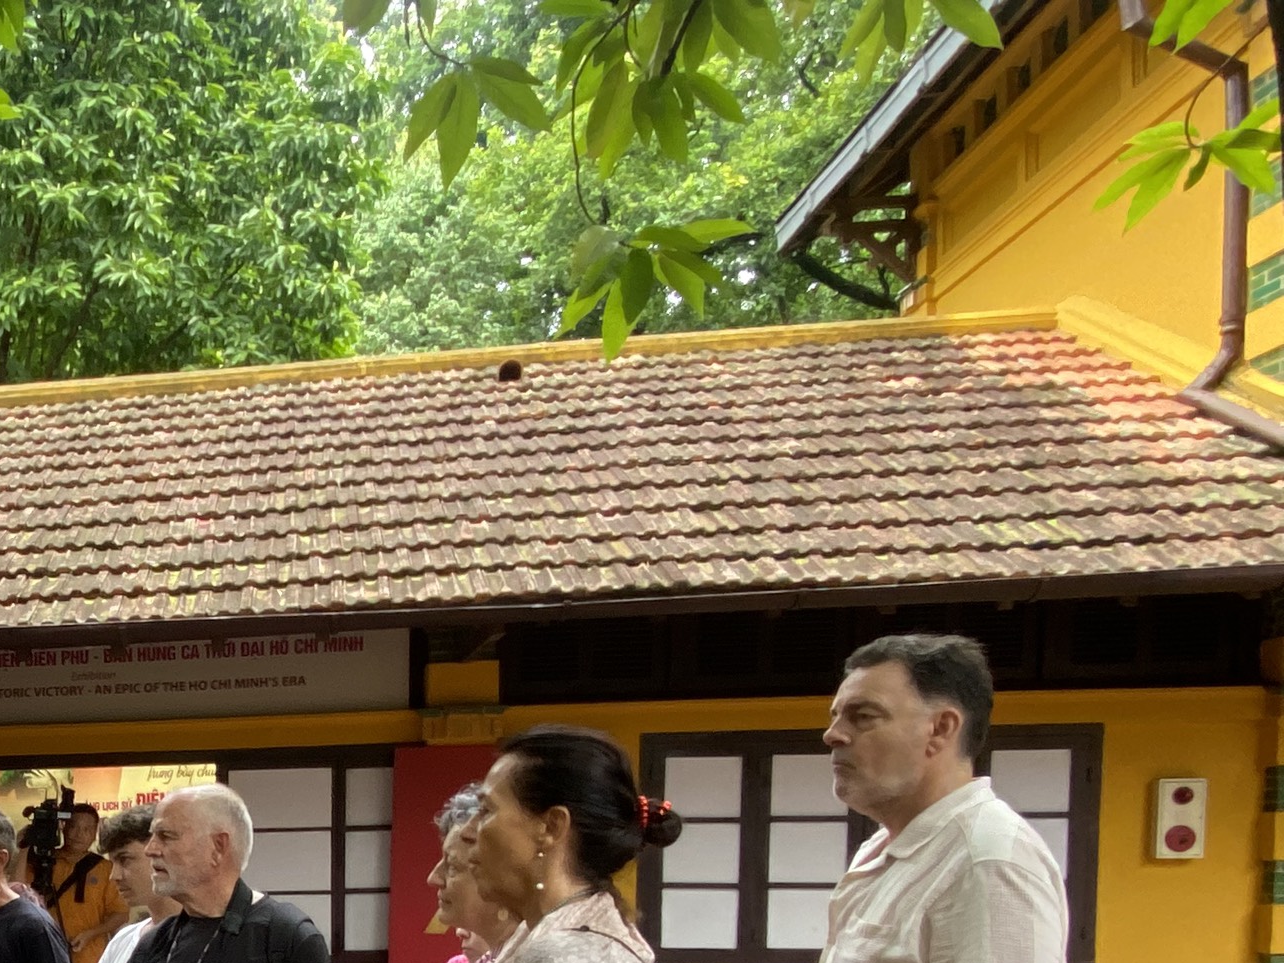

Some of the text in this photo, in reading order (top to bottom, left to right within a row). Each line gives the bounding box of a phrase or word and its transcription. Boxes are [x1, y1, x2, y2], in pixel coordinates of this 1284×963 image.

[181, 643, 200, 660] CA
[324, 636, 364, 653] MINH
[34, 685, 85, 697] VICTORY
[94, 684, 112, 695] AN
[114, 683, 142, 694] EPIC
[143, 682, 159, 693] OF
[161, 681, 186, 692] THE
[188, 681, 207, 692] HO
[210, 679, 231, 691] CHI
[234, 677, 279, 689] MINH'S
[282, 676, 307, 687] ERA
